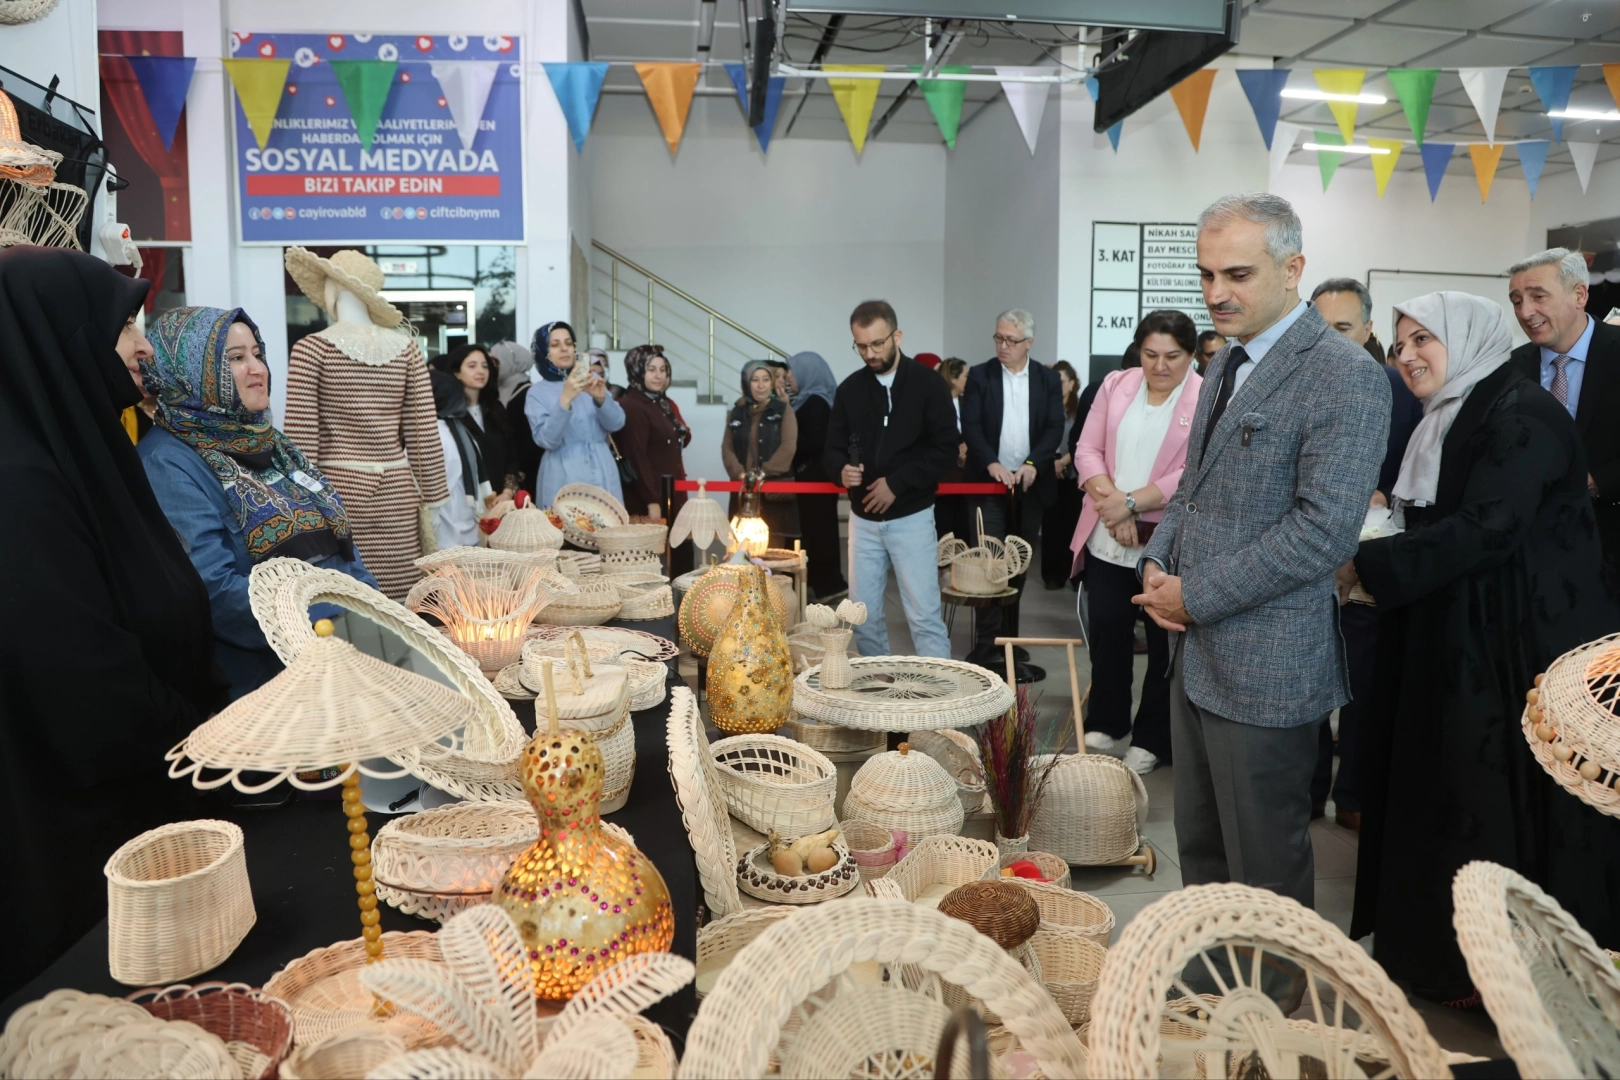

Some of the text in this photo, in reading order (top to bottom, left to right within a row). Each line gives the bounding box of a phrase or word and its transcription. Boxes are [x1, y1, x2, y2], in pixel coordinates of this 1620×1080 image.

[302, 133, 362, 144] HABERDA
[371, 133, 415, 145] OLMAK
[245, 148, 499, 172] SOSYAL MEDYADA
[304, 177, 442, 193] BİZİ TAKİP EDİN
[1148, 228, 1197, 238] NİKAH SAL
[1147, 245, 1196, 254] BAY MESCİ
[1098, 249, 1135, 263] 3. KAT
[1147, 261, 1186, 270] FOTOĞRAF
[1147, 277, 1172, 287] KÜLTÜR
[1173, 279, 1198, 287] SALONU
[1146, 295, 1193, 304] EVLENDİRME
[1096, 316, 1133, 329] 2. KAT
